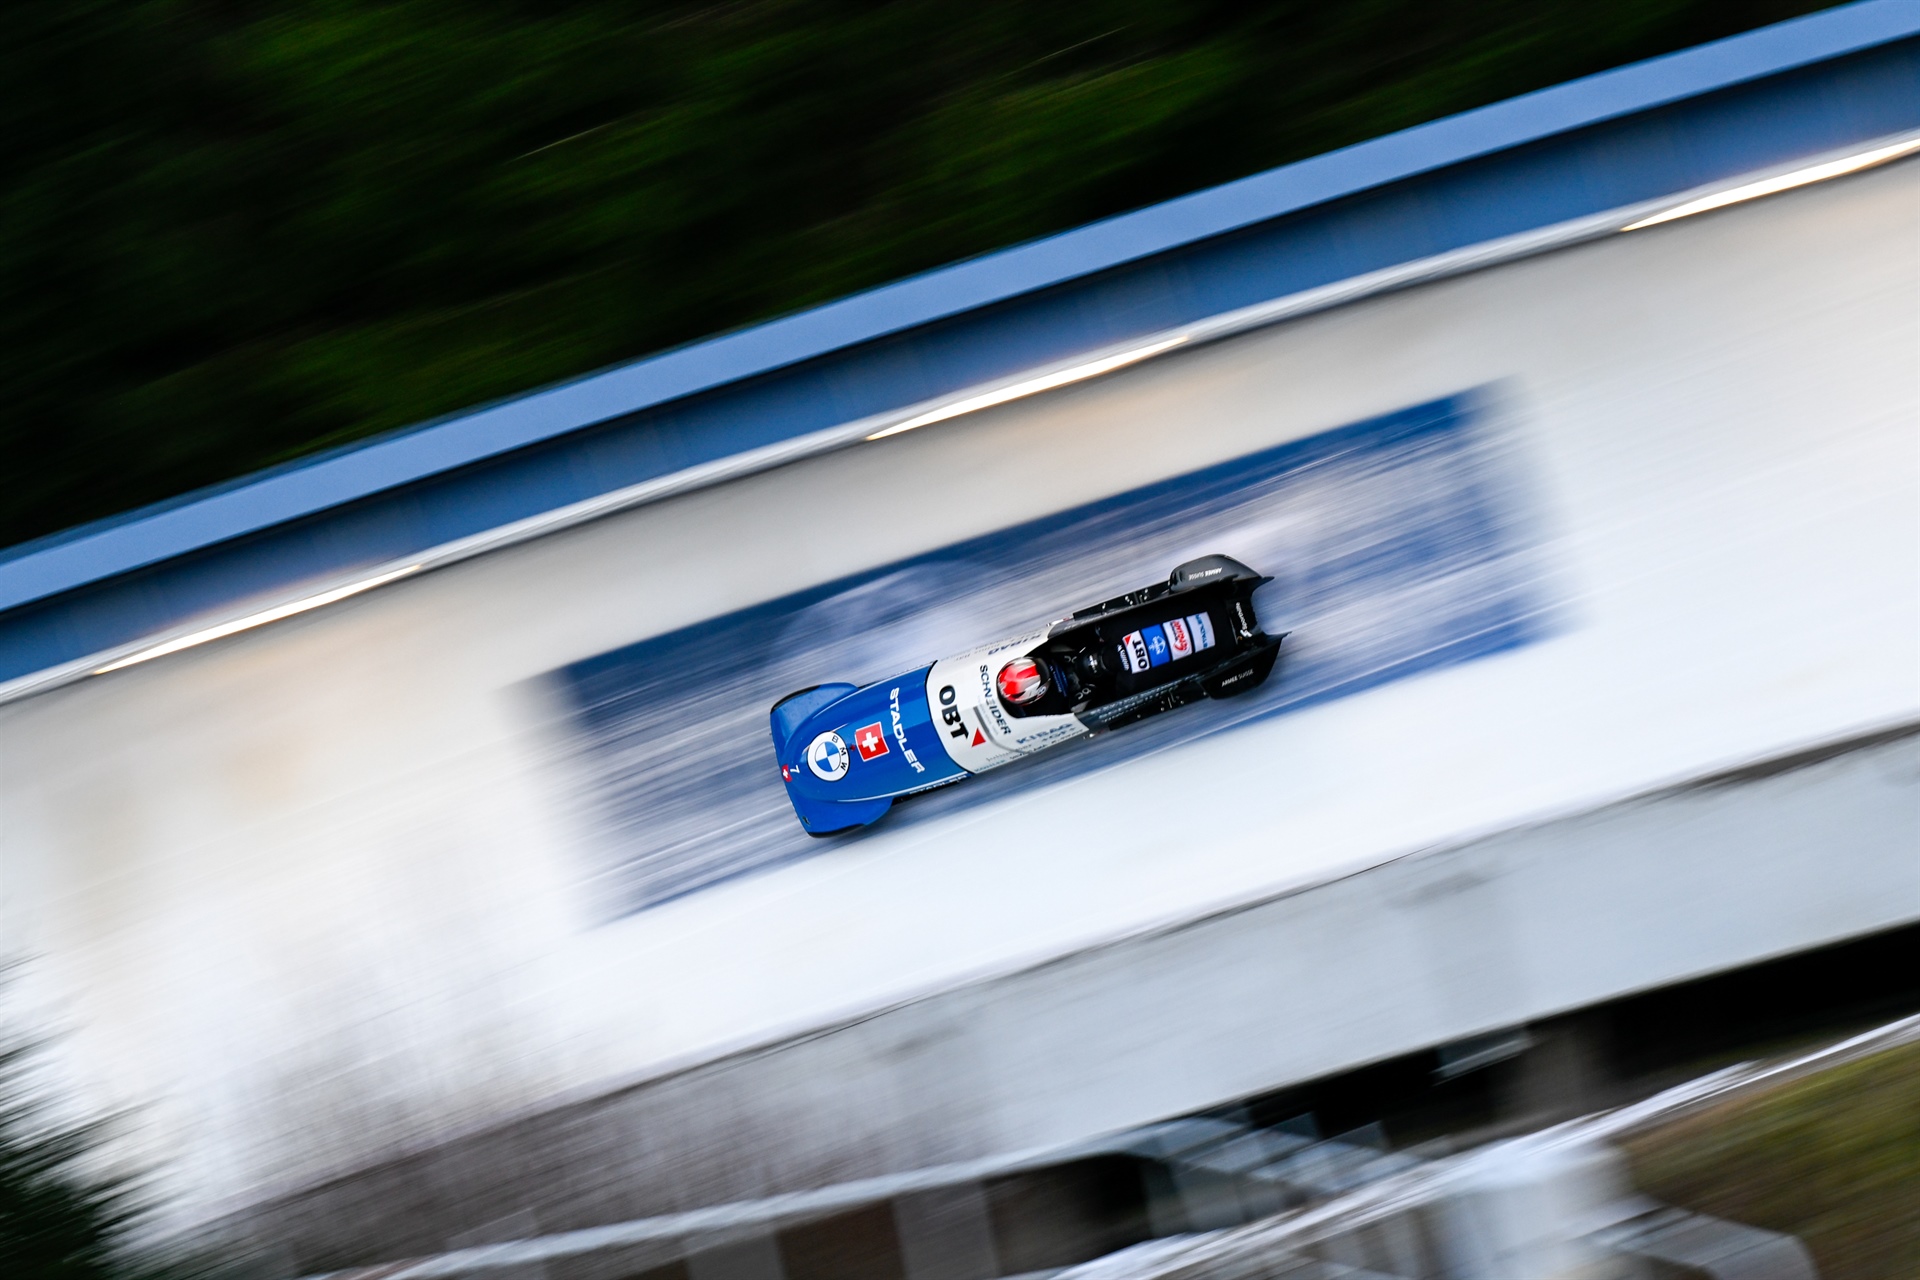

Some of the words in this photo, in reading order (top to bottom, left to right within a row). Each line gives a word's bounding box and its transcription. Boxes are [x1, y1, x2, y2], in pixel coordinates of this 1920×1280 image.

[1195, 614, 1208, 648] STADLER
[1132, 640, 1148, 669] OBT
[1221, 675, 1238, 687] ARMEE
[939, 684, 969, 740] OBT
[980, 664, 1012, 735] SCHNEIDER
[889, 687, 925, 774] STADLER
[1016, 723, 1073, 745] KIBAG
[790, 765, 800, 774] 7
[831, 735, 848, 771] BMW
